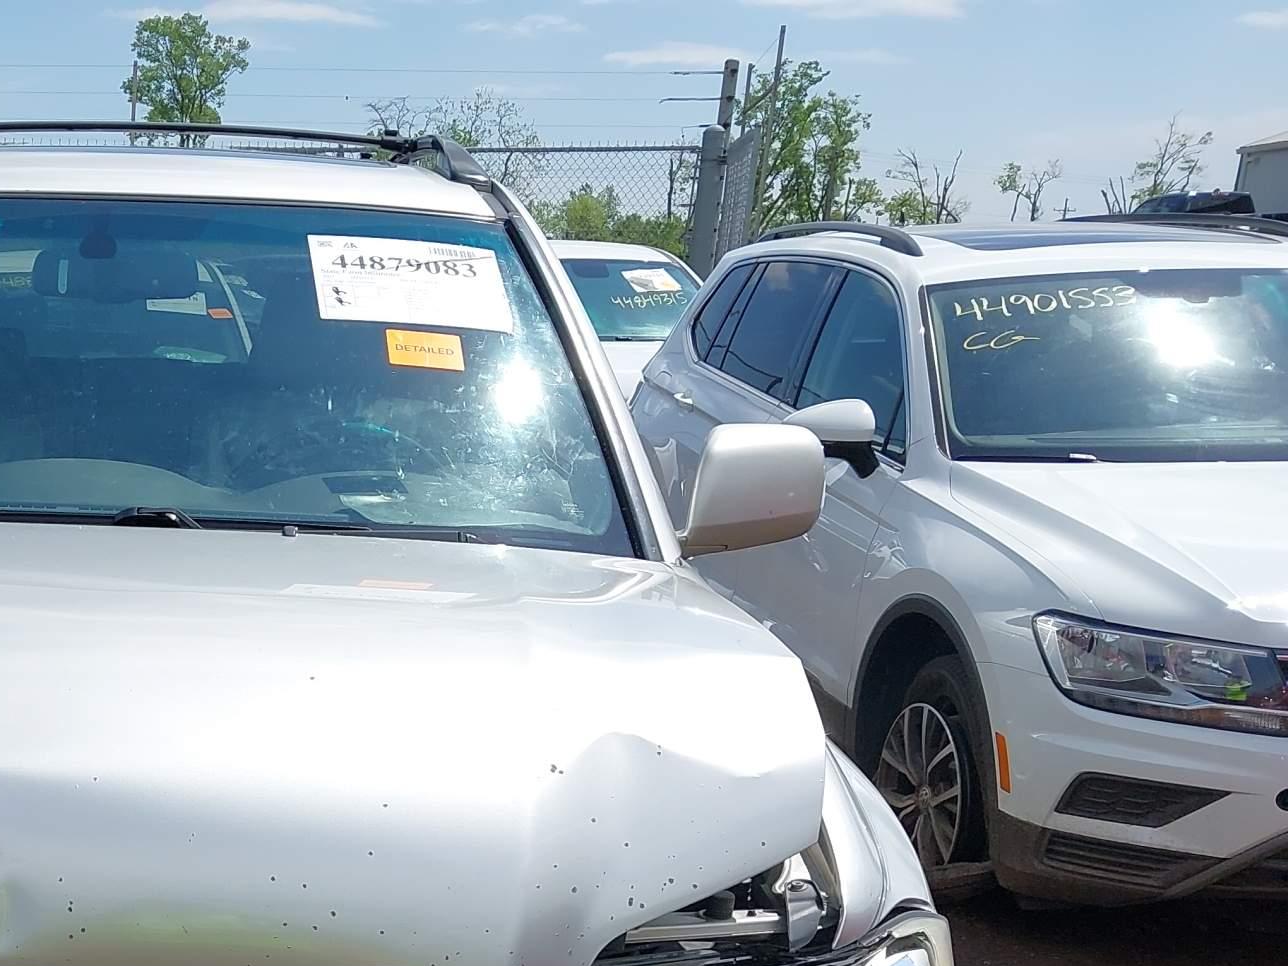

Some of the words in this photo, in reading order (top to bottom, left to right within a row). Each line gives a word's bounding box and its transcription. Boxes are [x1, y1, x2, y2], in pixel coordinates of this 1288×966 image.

[331, 254, 477, 278] 44879083
[955, 285, 1137, 321] 44901553
[394, 343, 455, 356] DETAILED
